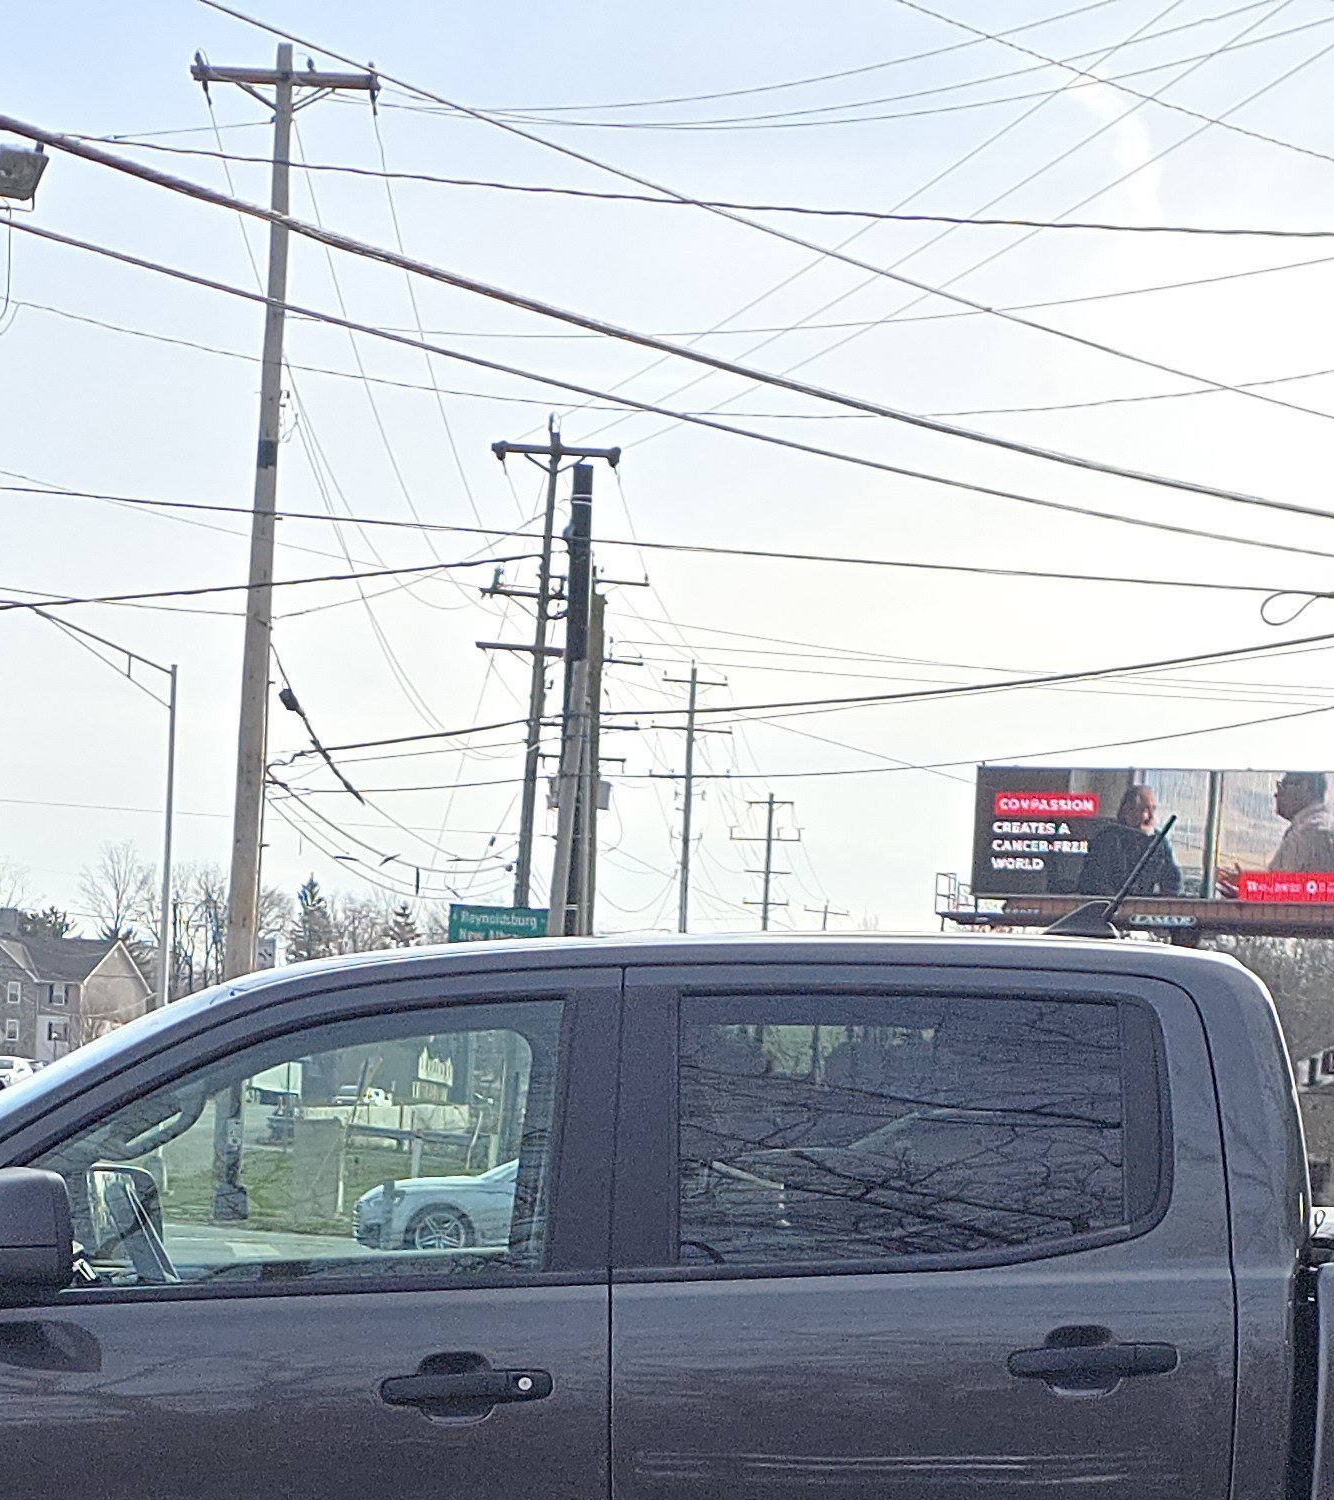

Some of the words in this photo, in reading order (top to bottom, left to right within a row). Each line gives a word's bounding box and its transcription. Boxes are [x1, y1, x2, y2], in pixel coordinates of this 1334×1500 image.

[998, 797, 1095, 812] COMPASSION
[992, 821, 1056, 834] CREATES
[1058, 822, 1071, 835] A
[990, 856, 1045, 870] WORLD
